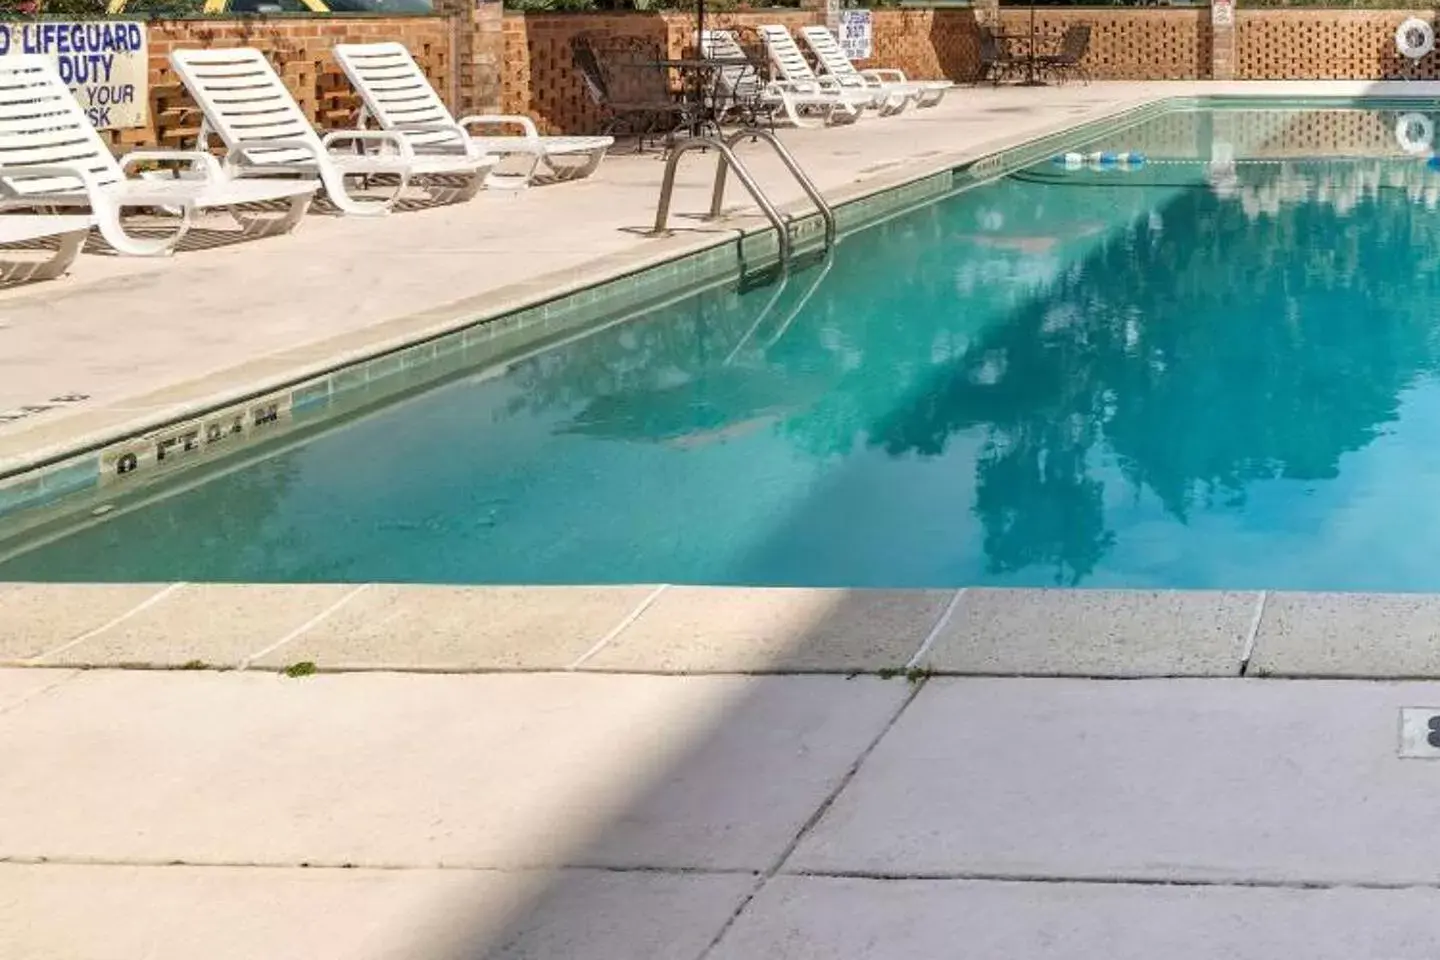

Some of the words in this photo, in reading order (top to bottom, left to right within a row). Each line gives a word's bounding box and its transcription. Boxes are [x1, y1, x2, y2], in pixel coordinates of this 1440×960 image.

[23, 23, 141, 54] LIFEGUARD
[58, 54, 114, 85] DUTY
[87, 84, 135, 106] YOUR
